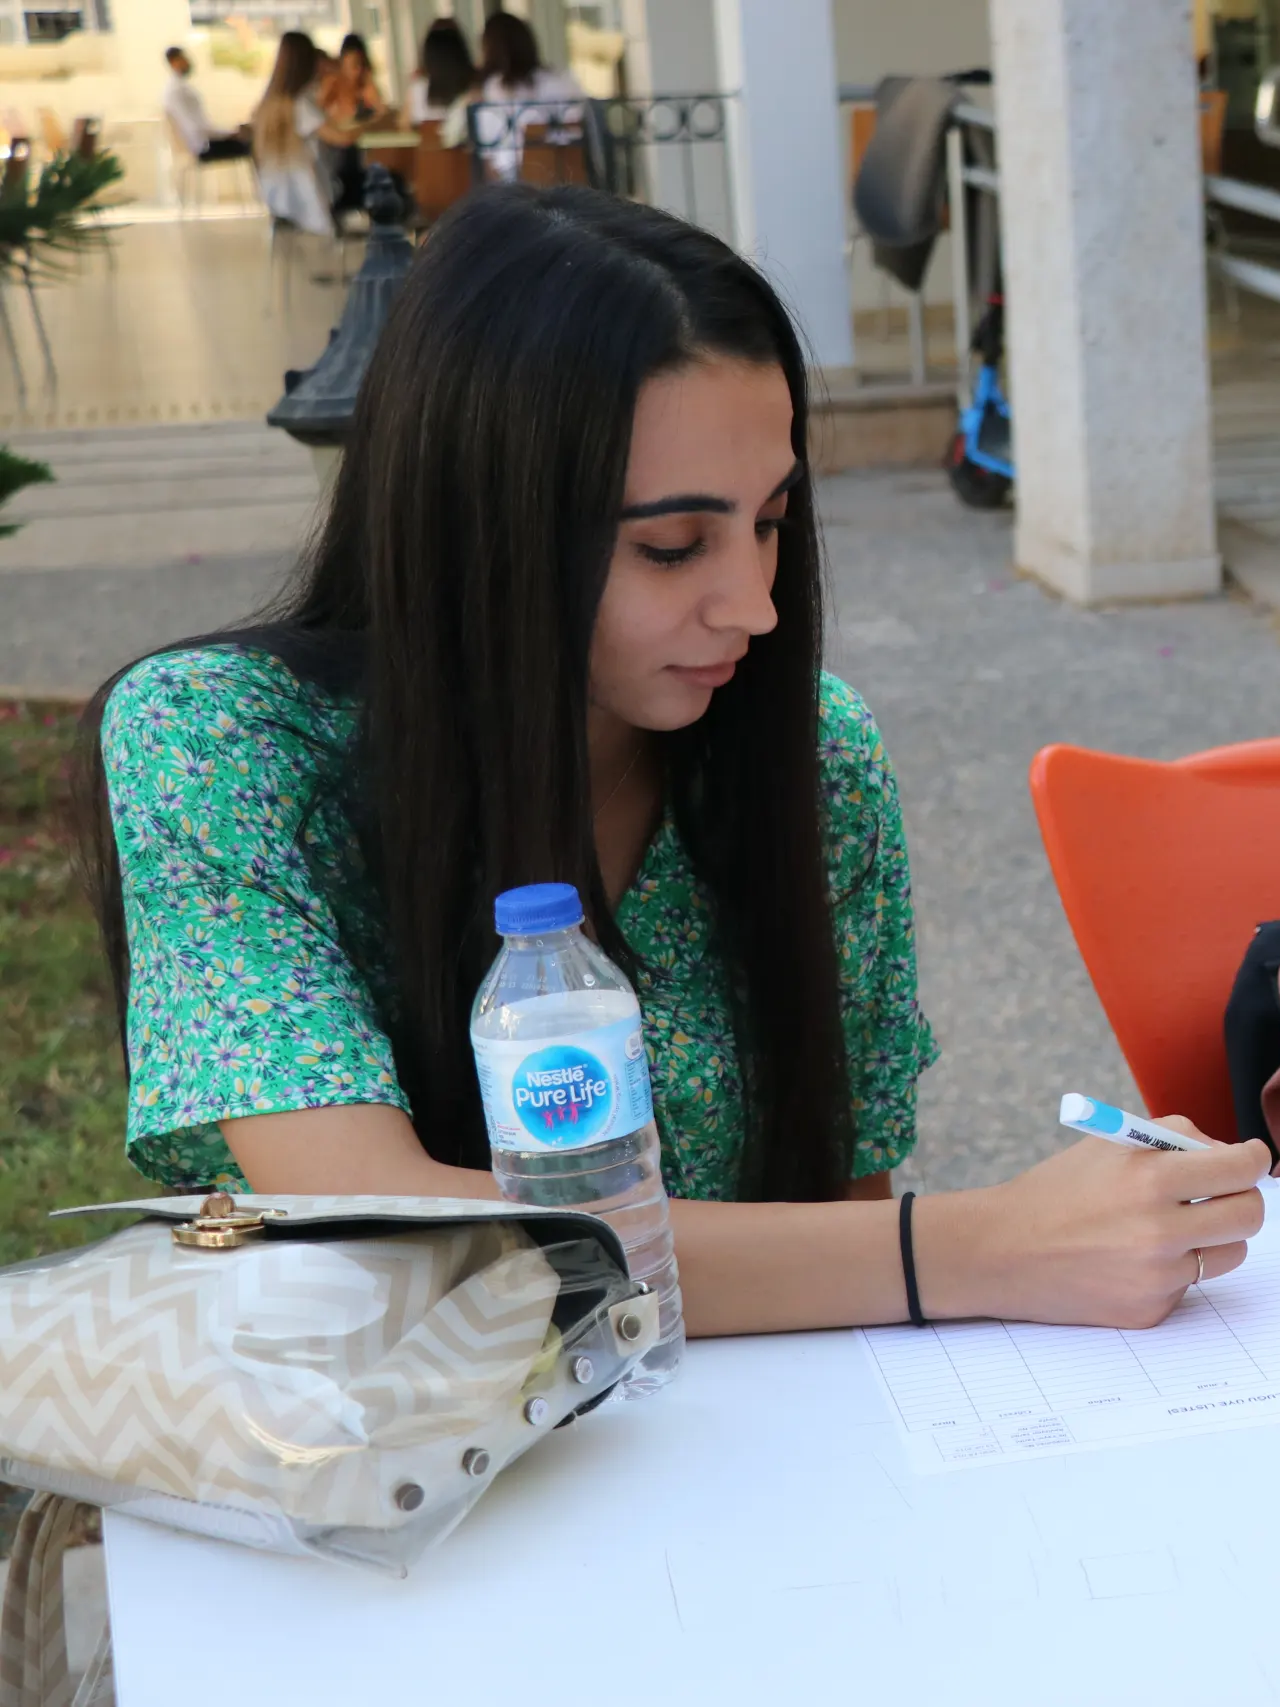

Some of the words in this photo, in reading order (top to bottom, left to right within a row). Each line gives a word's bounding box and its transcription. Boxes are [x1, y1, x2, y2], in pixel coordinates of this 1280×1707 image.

[515, 1084, 567, 1108] Pure
[570, 1079, 607, 1108] Life
[1126, 1128, 1153, 1144] PROMISE
[1150, 1137, 1177, 1151] STUDENT
